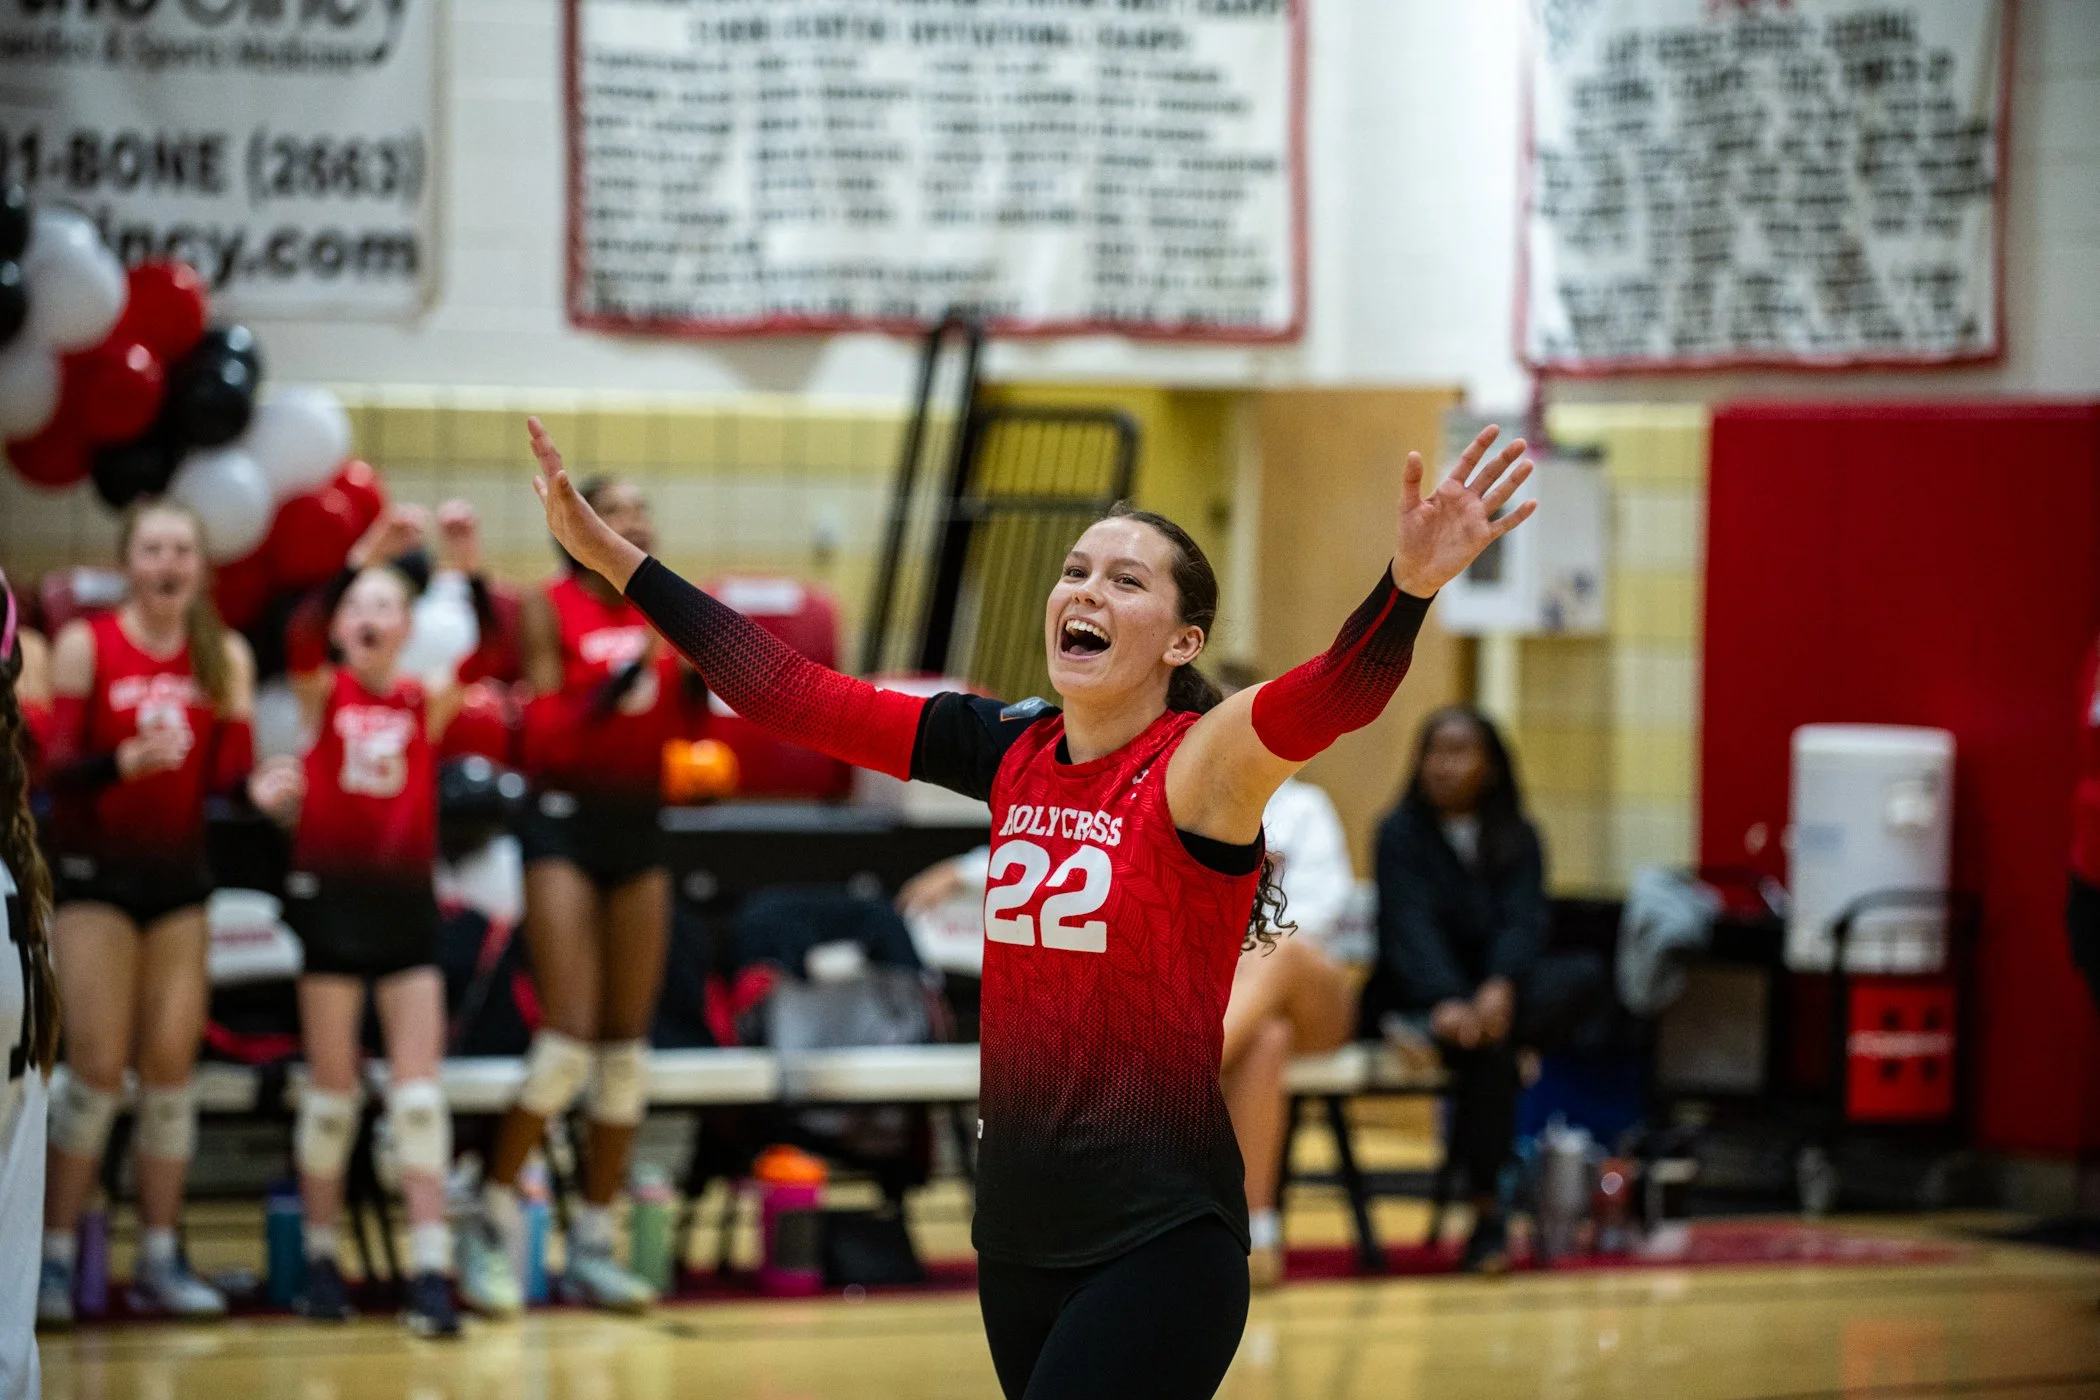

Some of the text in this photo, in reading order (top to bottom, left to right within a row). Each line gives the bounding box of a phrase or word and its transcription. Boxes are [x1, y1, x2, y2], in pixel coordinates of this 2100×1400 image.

[0, 127, 229, 194] 1-BONE
[95, 204, 421, 289] incy.com
[985, 839, 1113, 953] 22
